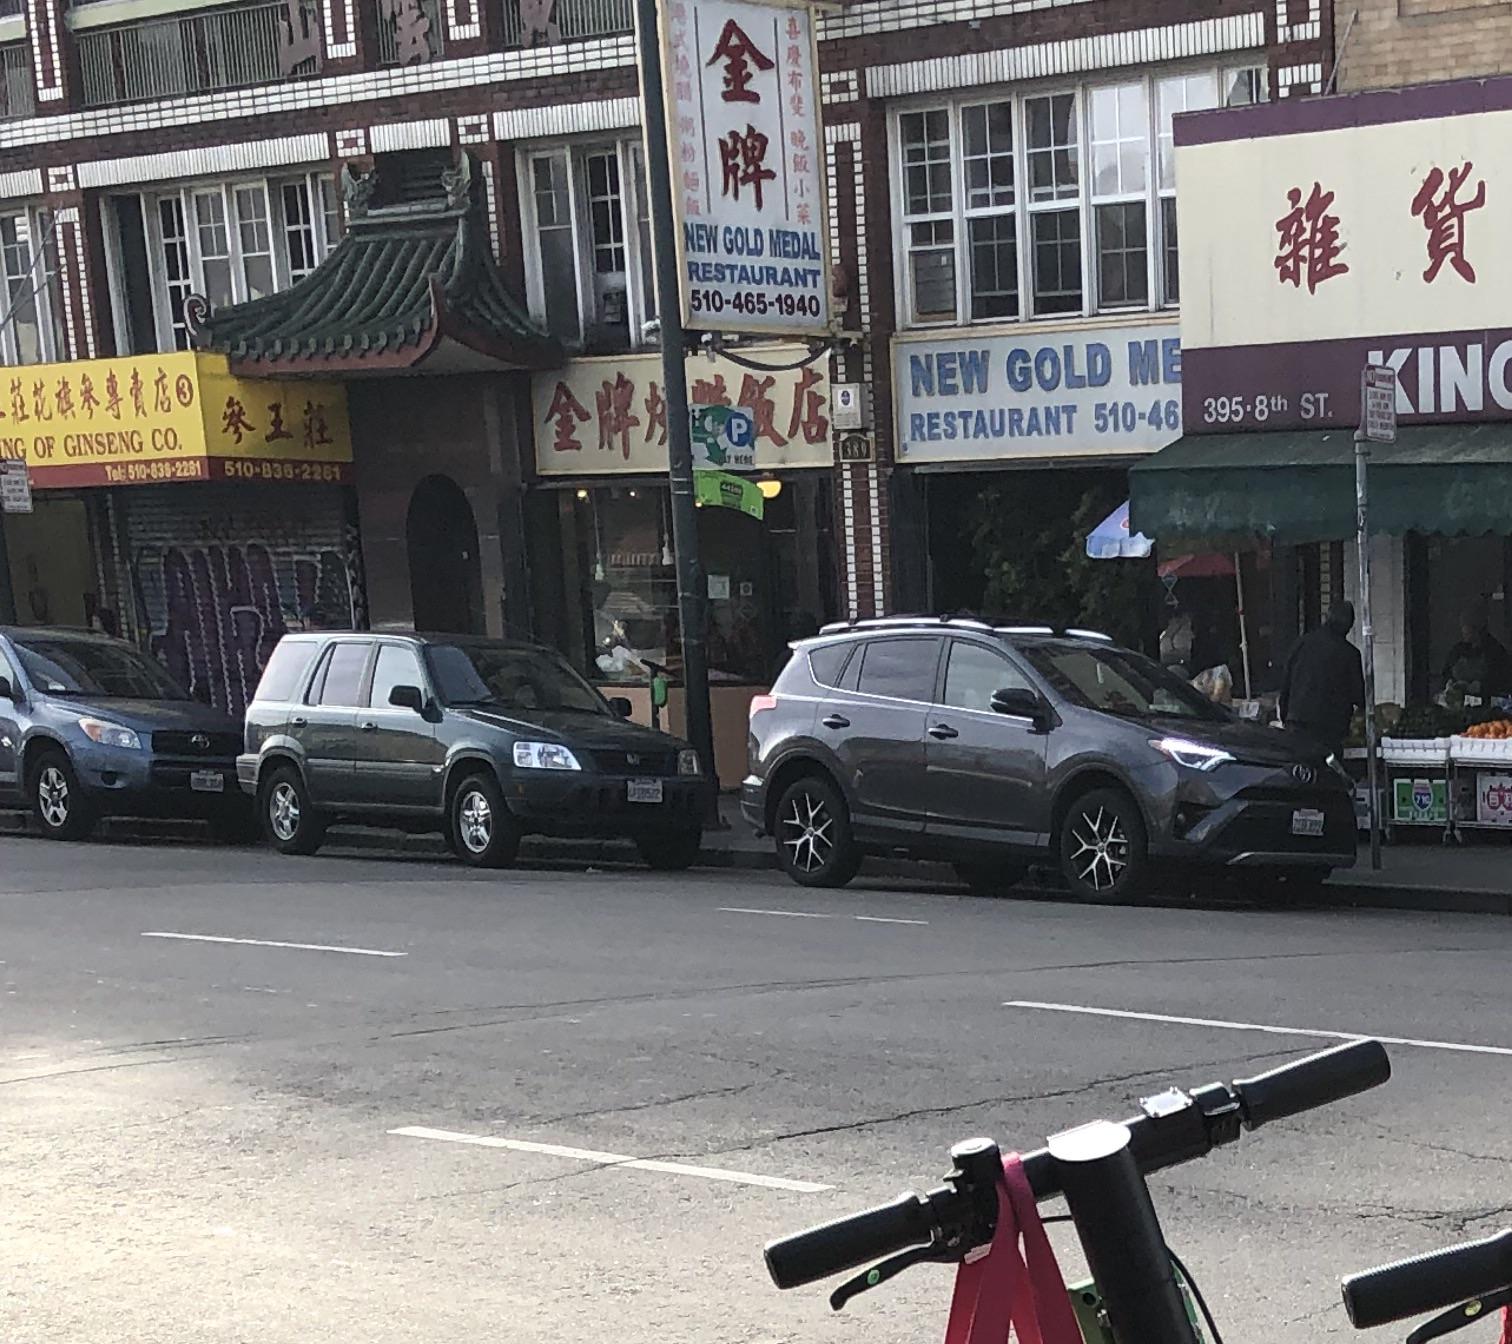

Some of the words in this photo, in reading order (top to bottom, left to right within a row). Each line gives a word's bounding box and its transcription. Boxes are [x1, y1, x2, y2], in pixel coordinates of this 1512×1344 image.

[705, 18, 777, 212] 金牌
[684, 222, 718, 254] NEW
[723, 226, 764, 257] GOLD
[768, 228, 821, 261] MEDAL
[687, 261, 821, 289] RESTAURANT
[691, 289, 821, 318] 510-465-1940
[910, 350, 991, 397] NEW
[1006, 343, 1112, 392] GOLD
[1299, 391, 1333, 420] ST.
[731, 417, 748, 443] P
[910, 404, 1078, 442] RESTAURANT
[0, 437, 27, 460] NG
[33, 435, 56, 459] OF
[64, 430, 144, 457] GINSENG
[152, 427, 183, 452] CO.
